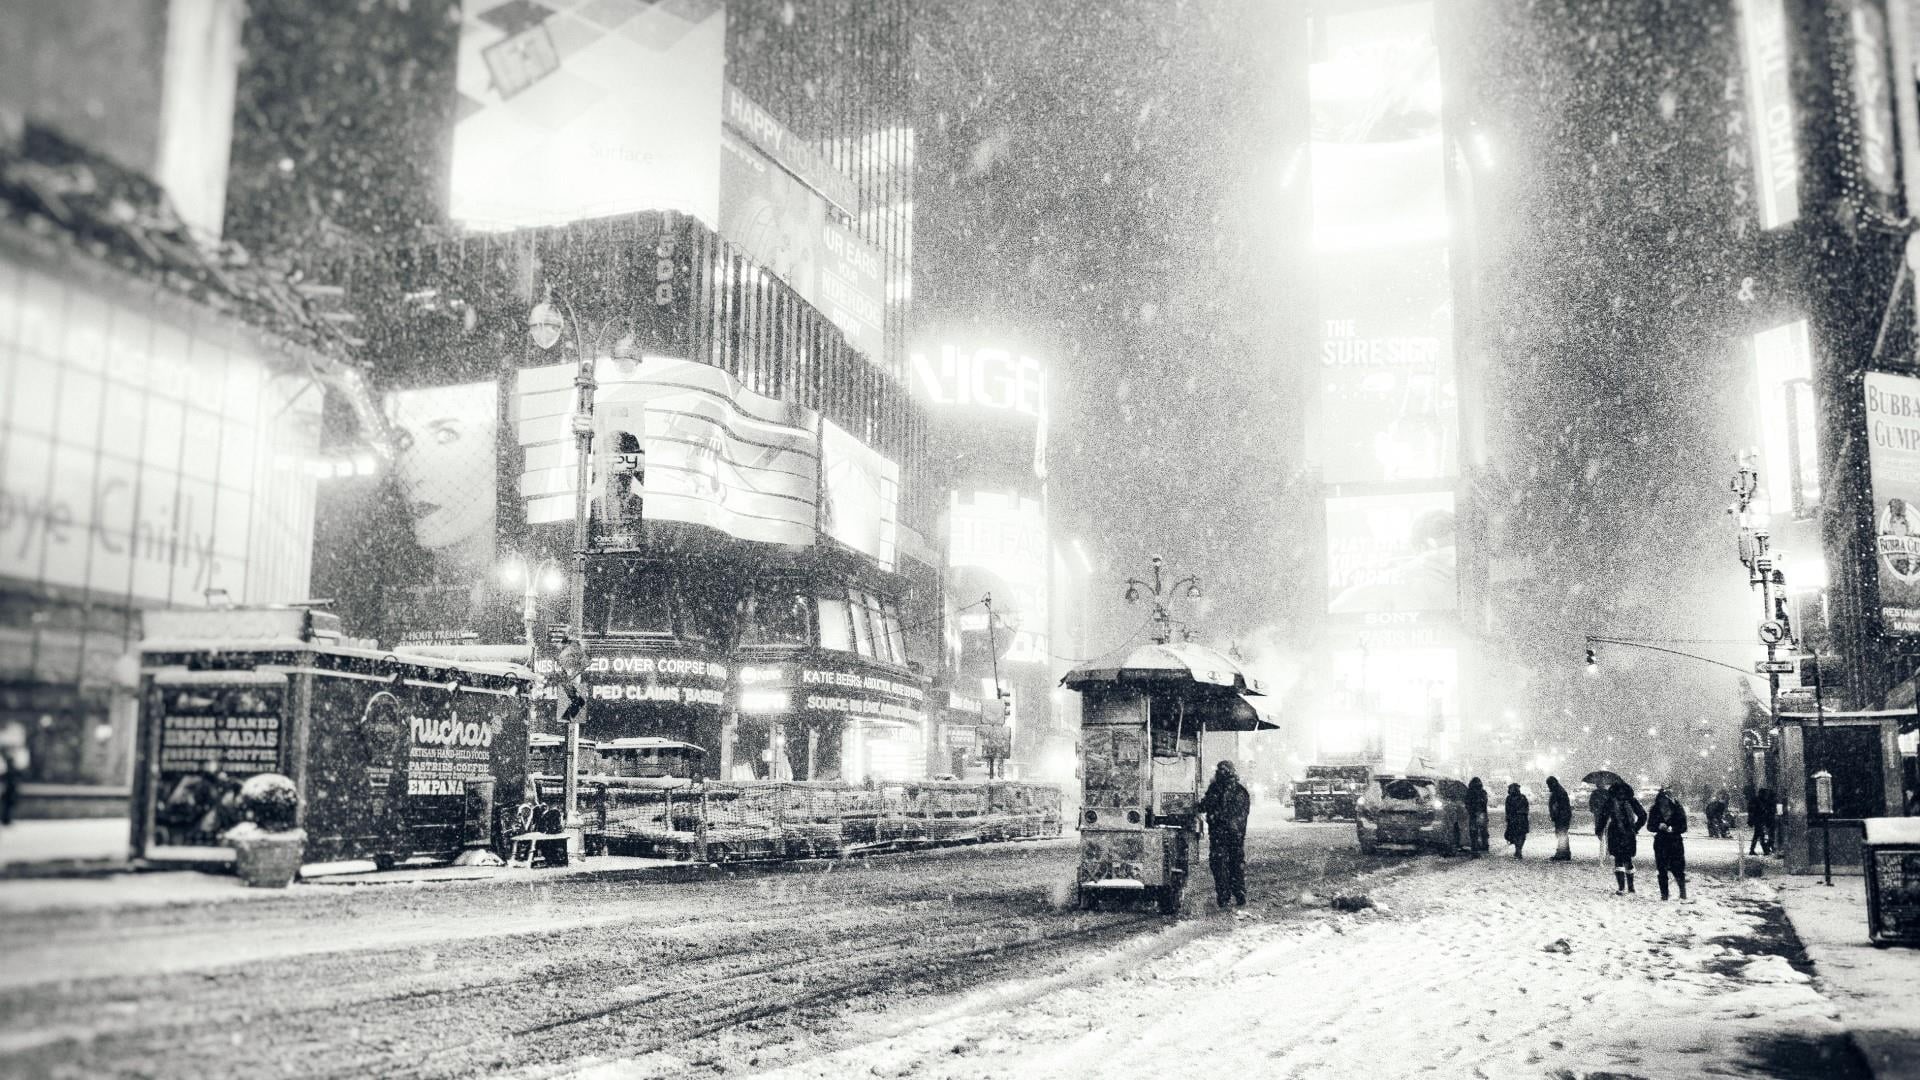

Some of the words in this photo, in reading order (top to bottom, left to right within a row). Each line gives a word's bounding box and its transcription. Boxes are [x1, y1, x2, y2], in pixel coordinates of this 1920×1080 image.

[730, 90, 783, 150] HAPPY
[823, 226, 844, 257] UR
[846, 241, 878, 281] EARS
[822, 271, 882, 326] NDERDOG
[1325, 319, 1357, 337] THE
[1321, 338, 1384, 365] SURE
[1364, 611, 1420, 625] SONY
[613, 657, 654, 672] OVER
[657, 658, 704, 675] CORPSE
[803, 670, 834, 684] KATIE
[592, 685, 622, 700] PED
[625, 686, 680, 702] CLAIMS
[410, 710, 492, 747] nuchas
[163, 730, 278, 747] EMPANADAS
[408, 761, 453, 772] PASTRIES
[407, 779, 465, 795] EMPANA
